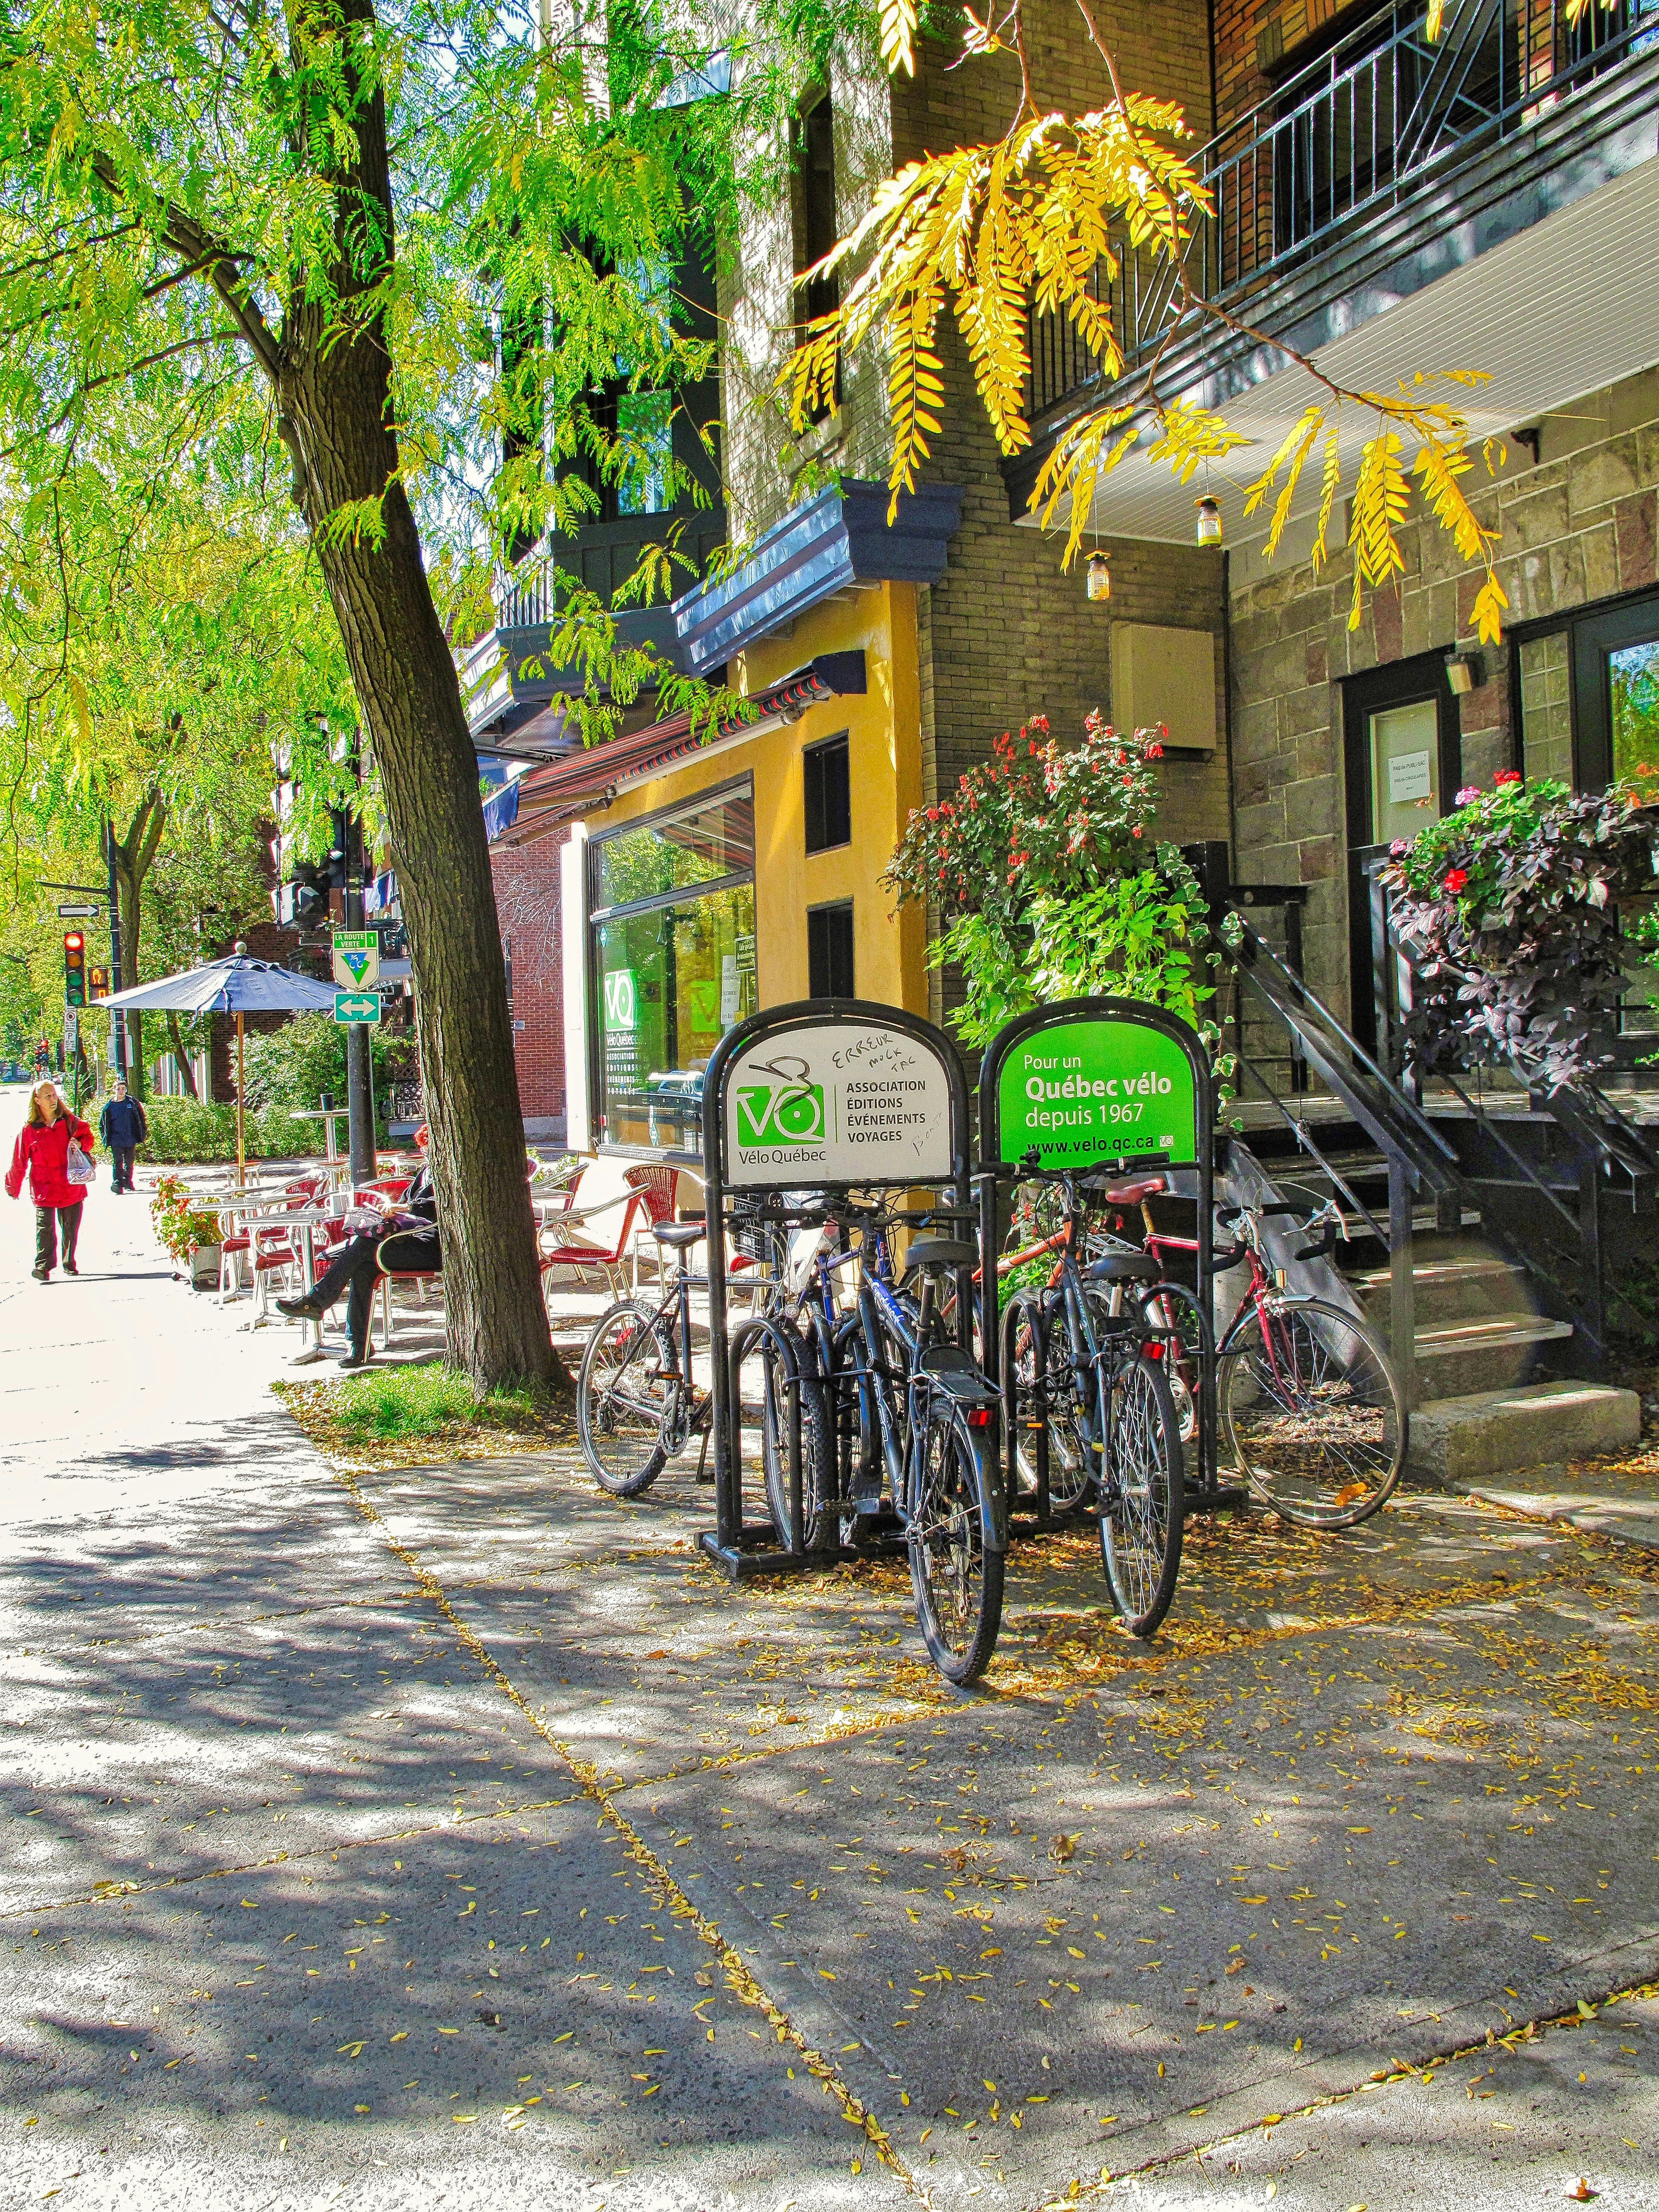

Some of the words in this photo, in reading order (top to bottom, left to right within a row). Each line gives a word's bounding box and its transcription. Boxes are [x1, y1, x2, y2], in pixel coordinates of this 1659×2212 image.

[369, 935, 374, 944] 1
[606, 973, 633, 1027] VQ
[832, 1033, 893, 1069] ERREUR
[1024, 1054, 1058, 1070] Pour
[1063, 1056, 1081, 1068] un
[846, 1080, 926, 1093] ASSOCIATION
[1025, 1073, 1118, 1102] Québec
[1122, 1071, 1172, 1096] vélo
[847, 1097, 903, 1110] ÉDITIONS
[847, 1113, 926, 1127] ÉVÉNEMENTS
[1026, 1106, 1092, 1132] depuis
[1099, 1102, 1143, 1124] 1967
[848, 1130, 902, 1143] VOYAGES
[1027, 1136, 1153, 1153] www.velo.qc.ca
[739, 1150, 769, 1165] Vélo
[771, 1148, 826, 1164] Québec
